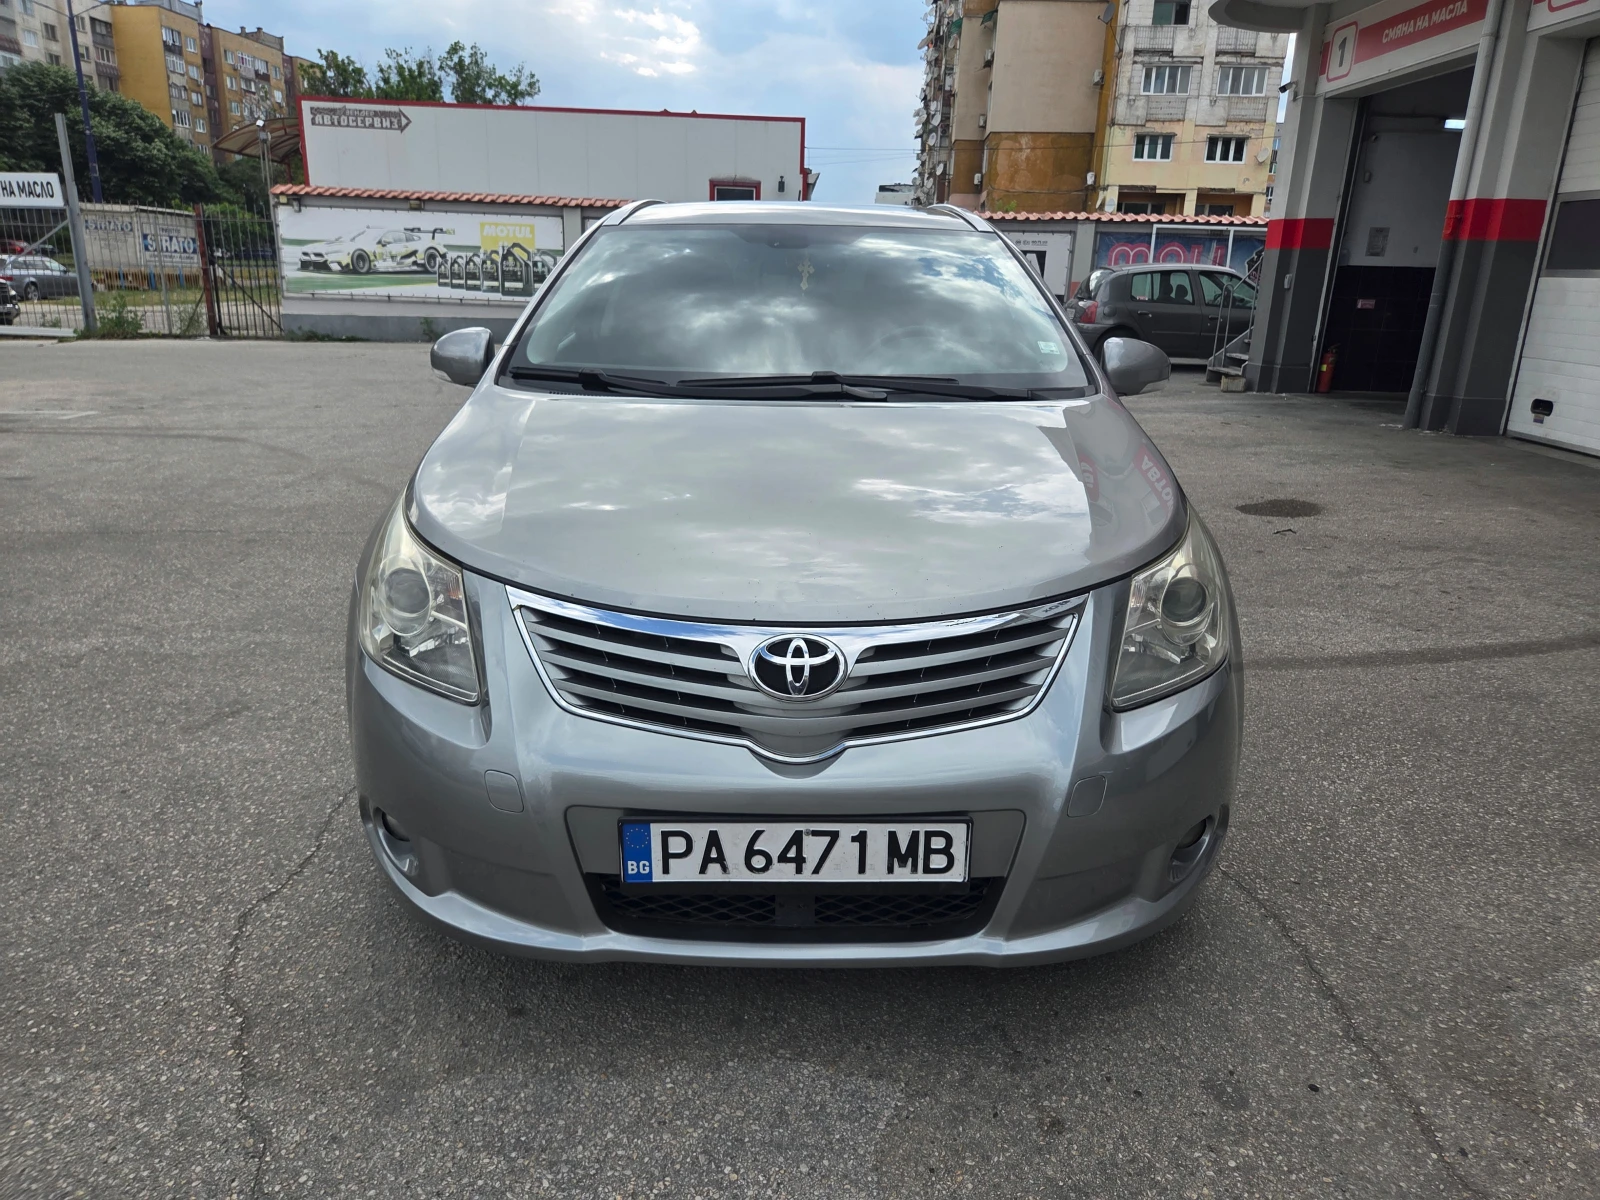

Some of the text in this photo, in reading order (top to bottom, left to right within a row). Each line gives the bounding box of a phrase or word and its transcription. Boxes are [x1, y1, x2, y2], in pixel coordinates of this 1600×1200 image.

[1382, 1, 1468, 44] СМЯНА НА МАСЛА
[1338, 36, 1348, 68] 1
[314, 114, 399, 129] АВТОСЕРВИЗ
[16, 180, 55, 199] МАСЛО
[482, 224, 533, 238] MOTUL
[660, 829, 955, 875] PA 6471 MB
[627, 860, 650, 875] BG
